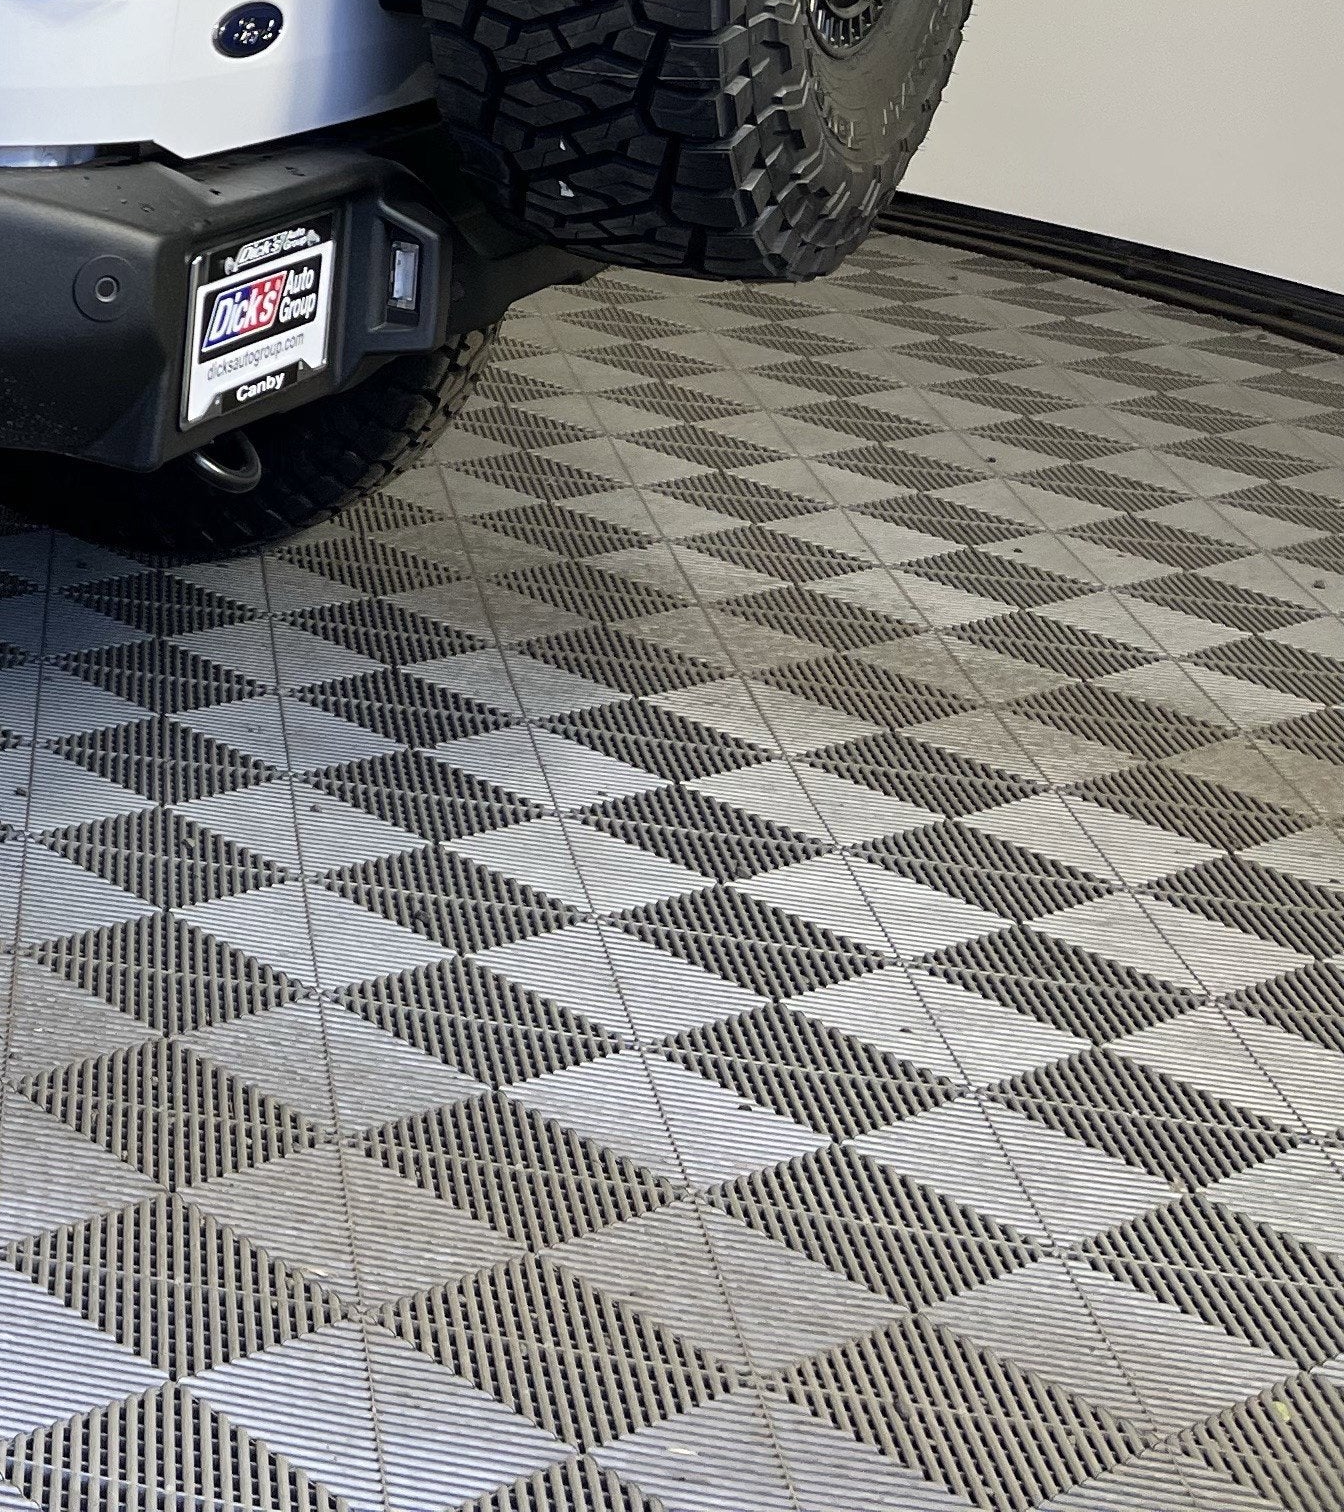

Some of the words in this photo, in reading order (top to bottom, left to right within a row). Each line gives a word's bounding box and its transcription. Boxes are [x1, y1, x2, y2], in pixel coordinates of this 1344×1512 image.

[283, 266, 315, 297] Auto
[279, 292, 317, 324] Group
[207, 332, 305, 381] dicksautogroup.com
[236, 372, 285, 402] Canby
